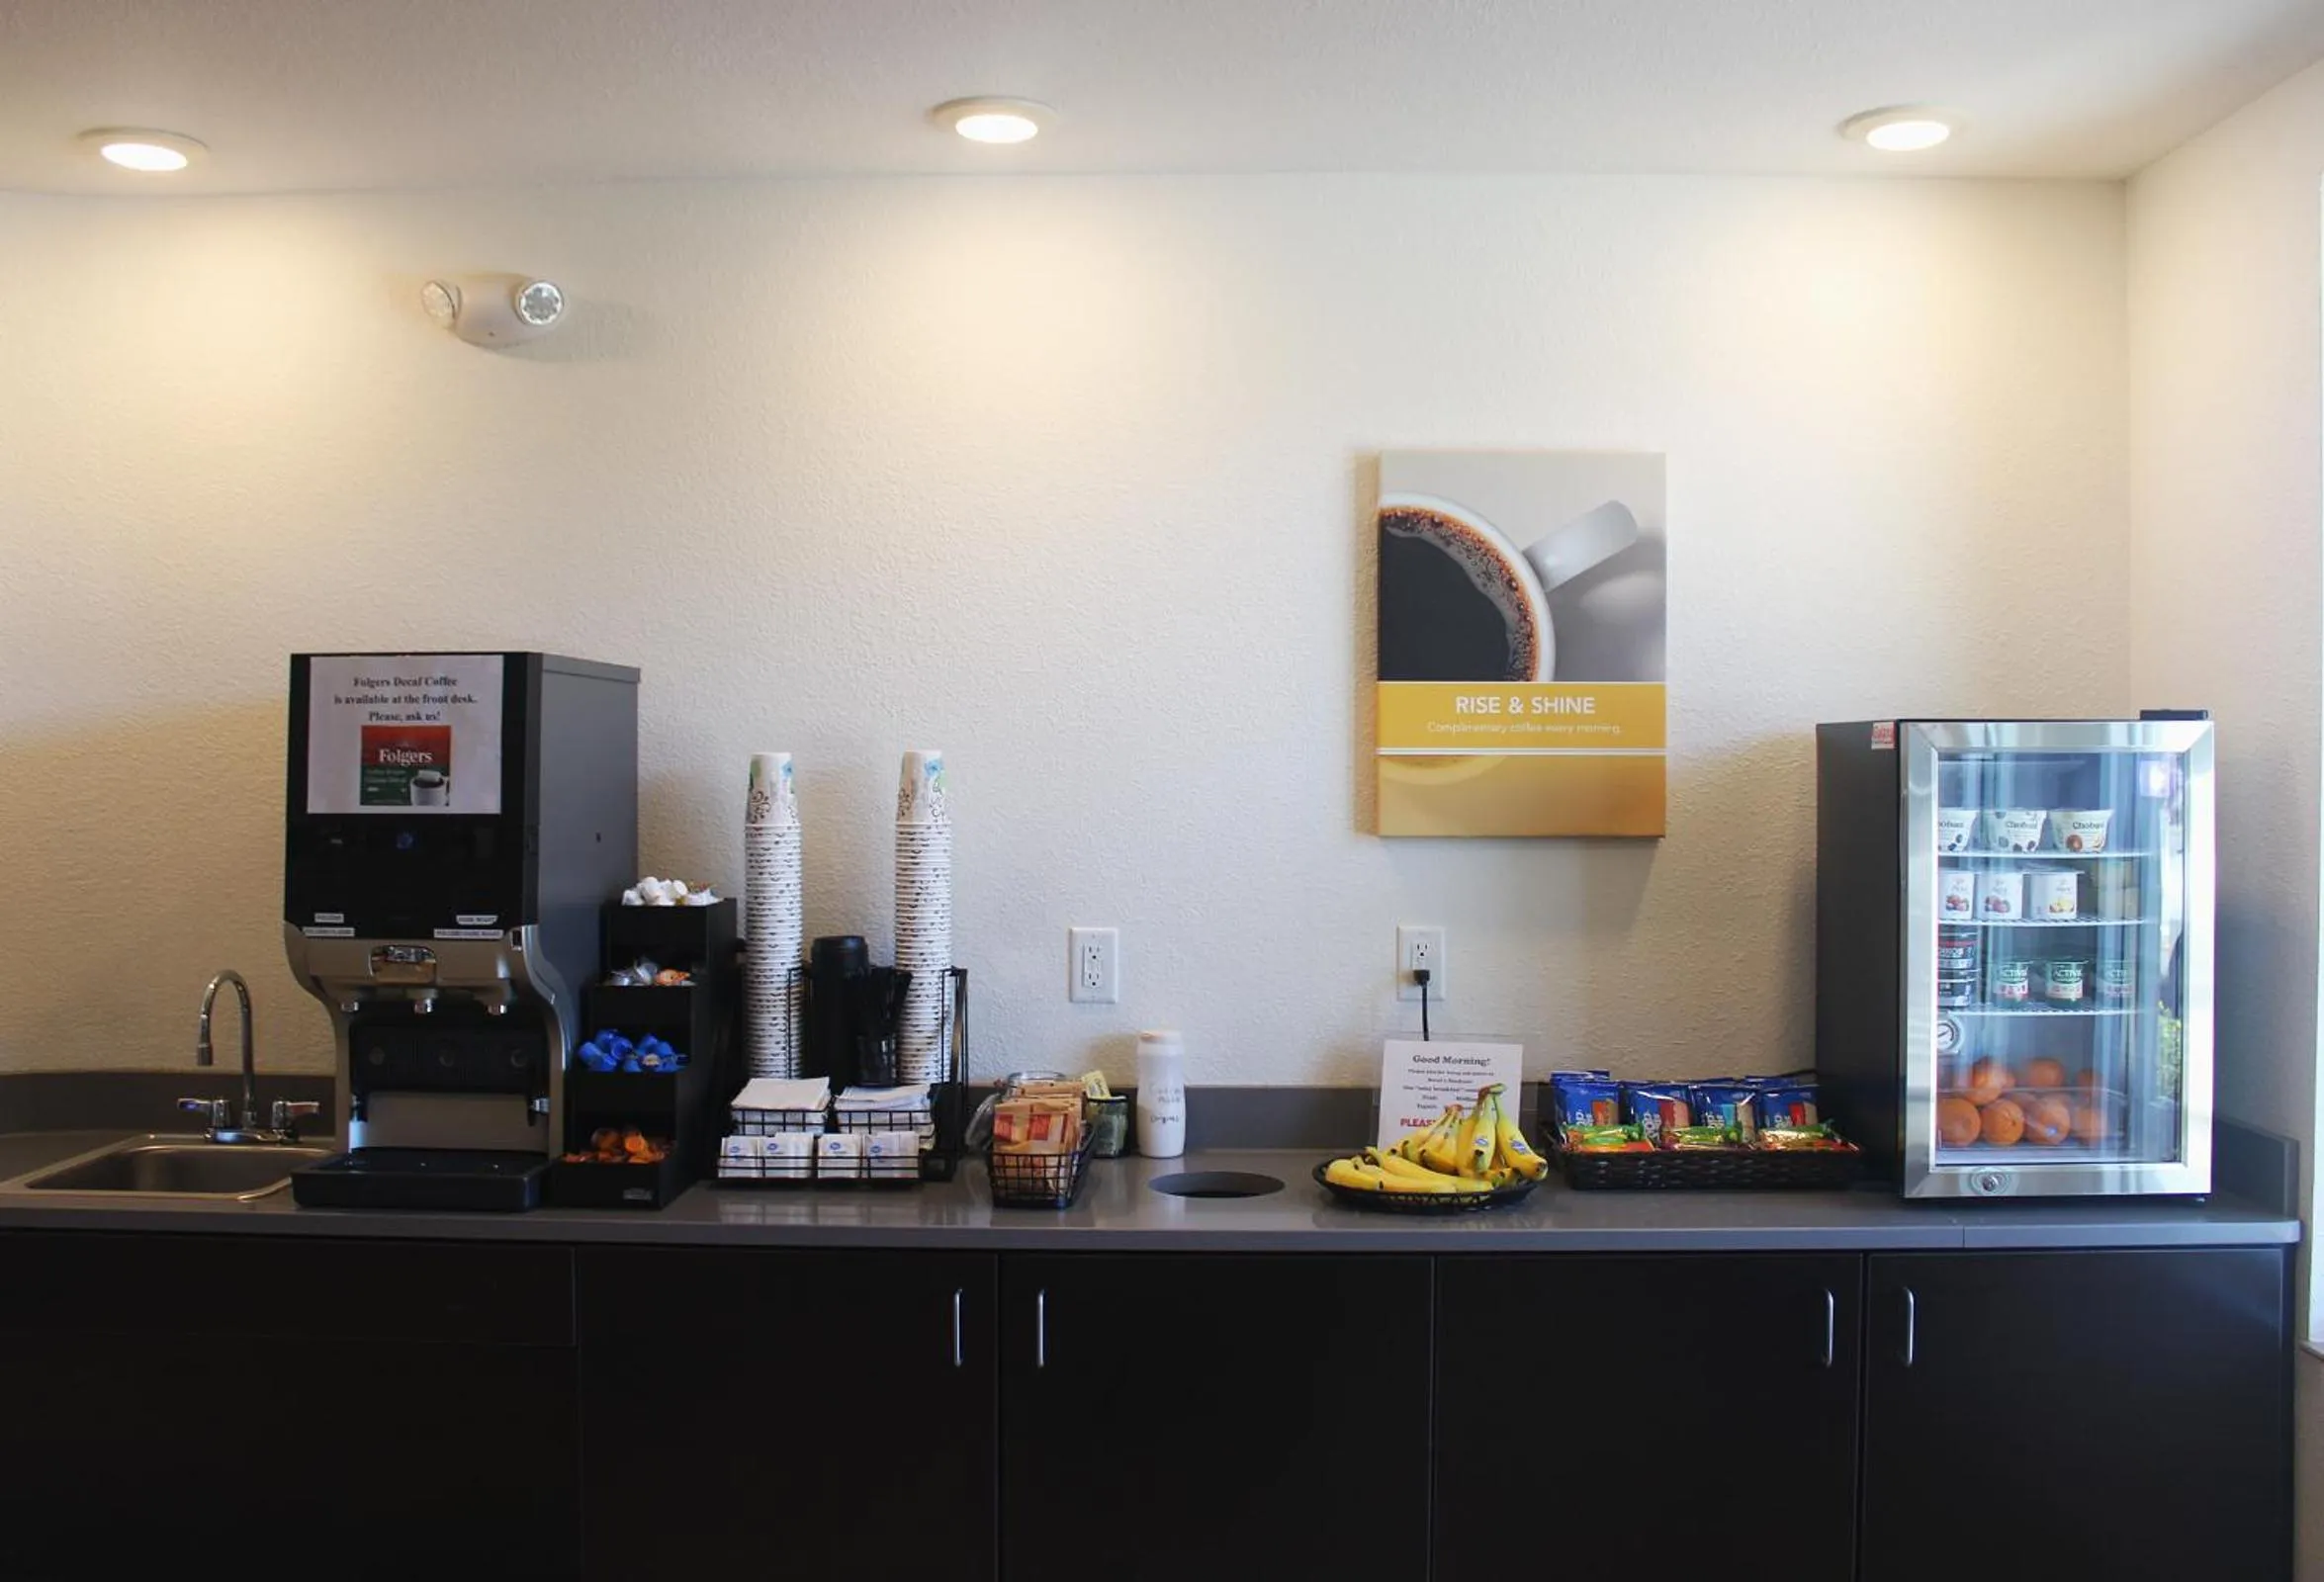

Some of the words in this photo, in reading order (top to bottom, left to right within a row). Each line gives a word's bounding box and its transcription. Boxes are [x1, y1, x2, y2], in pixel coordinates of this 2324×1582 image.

[353, 676, 391, 688] Folgers
[394, 676, 422, 686] Decaf
[424, 676, 458, 686] Coffee
[334, 695, 342, 704] is
[344, 694, 389, 704] available
[392, 695, 402, 704] at
[403, 694, 419, 704] the
[422, 694, 448, 704] front
[1456, 696, 1501, 714] RISE
[1508, 696, 1524, 714] &
[1531, 696, 1595, 714] SHINE
[405, 711, 422, 721] ask
[1427, 721, 1506, 735] Complimentary
[1510, 721, 1542, 733] coffee
[1546, 724, 1573, 735] every
[379, 748, 433, 767] Folgers
[1412, 1055, 1440, 1064] Good
[1442, 1056, 1491, 1067] Morning!
[1400, 1118, 1436, 1127] PLEAS
